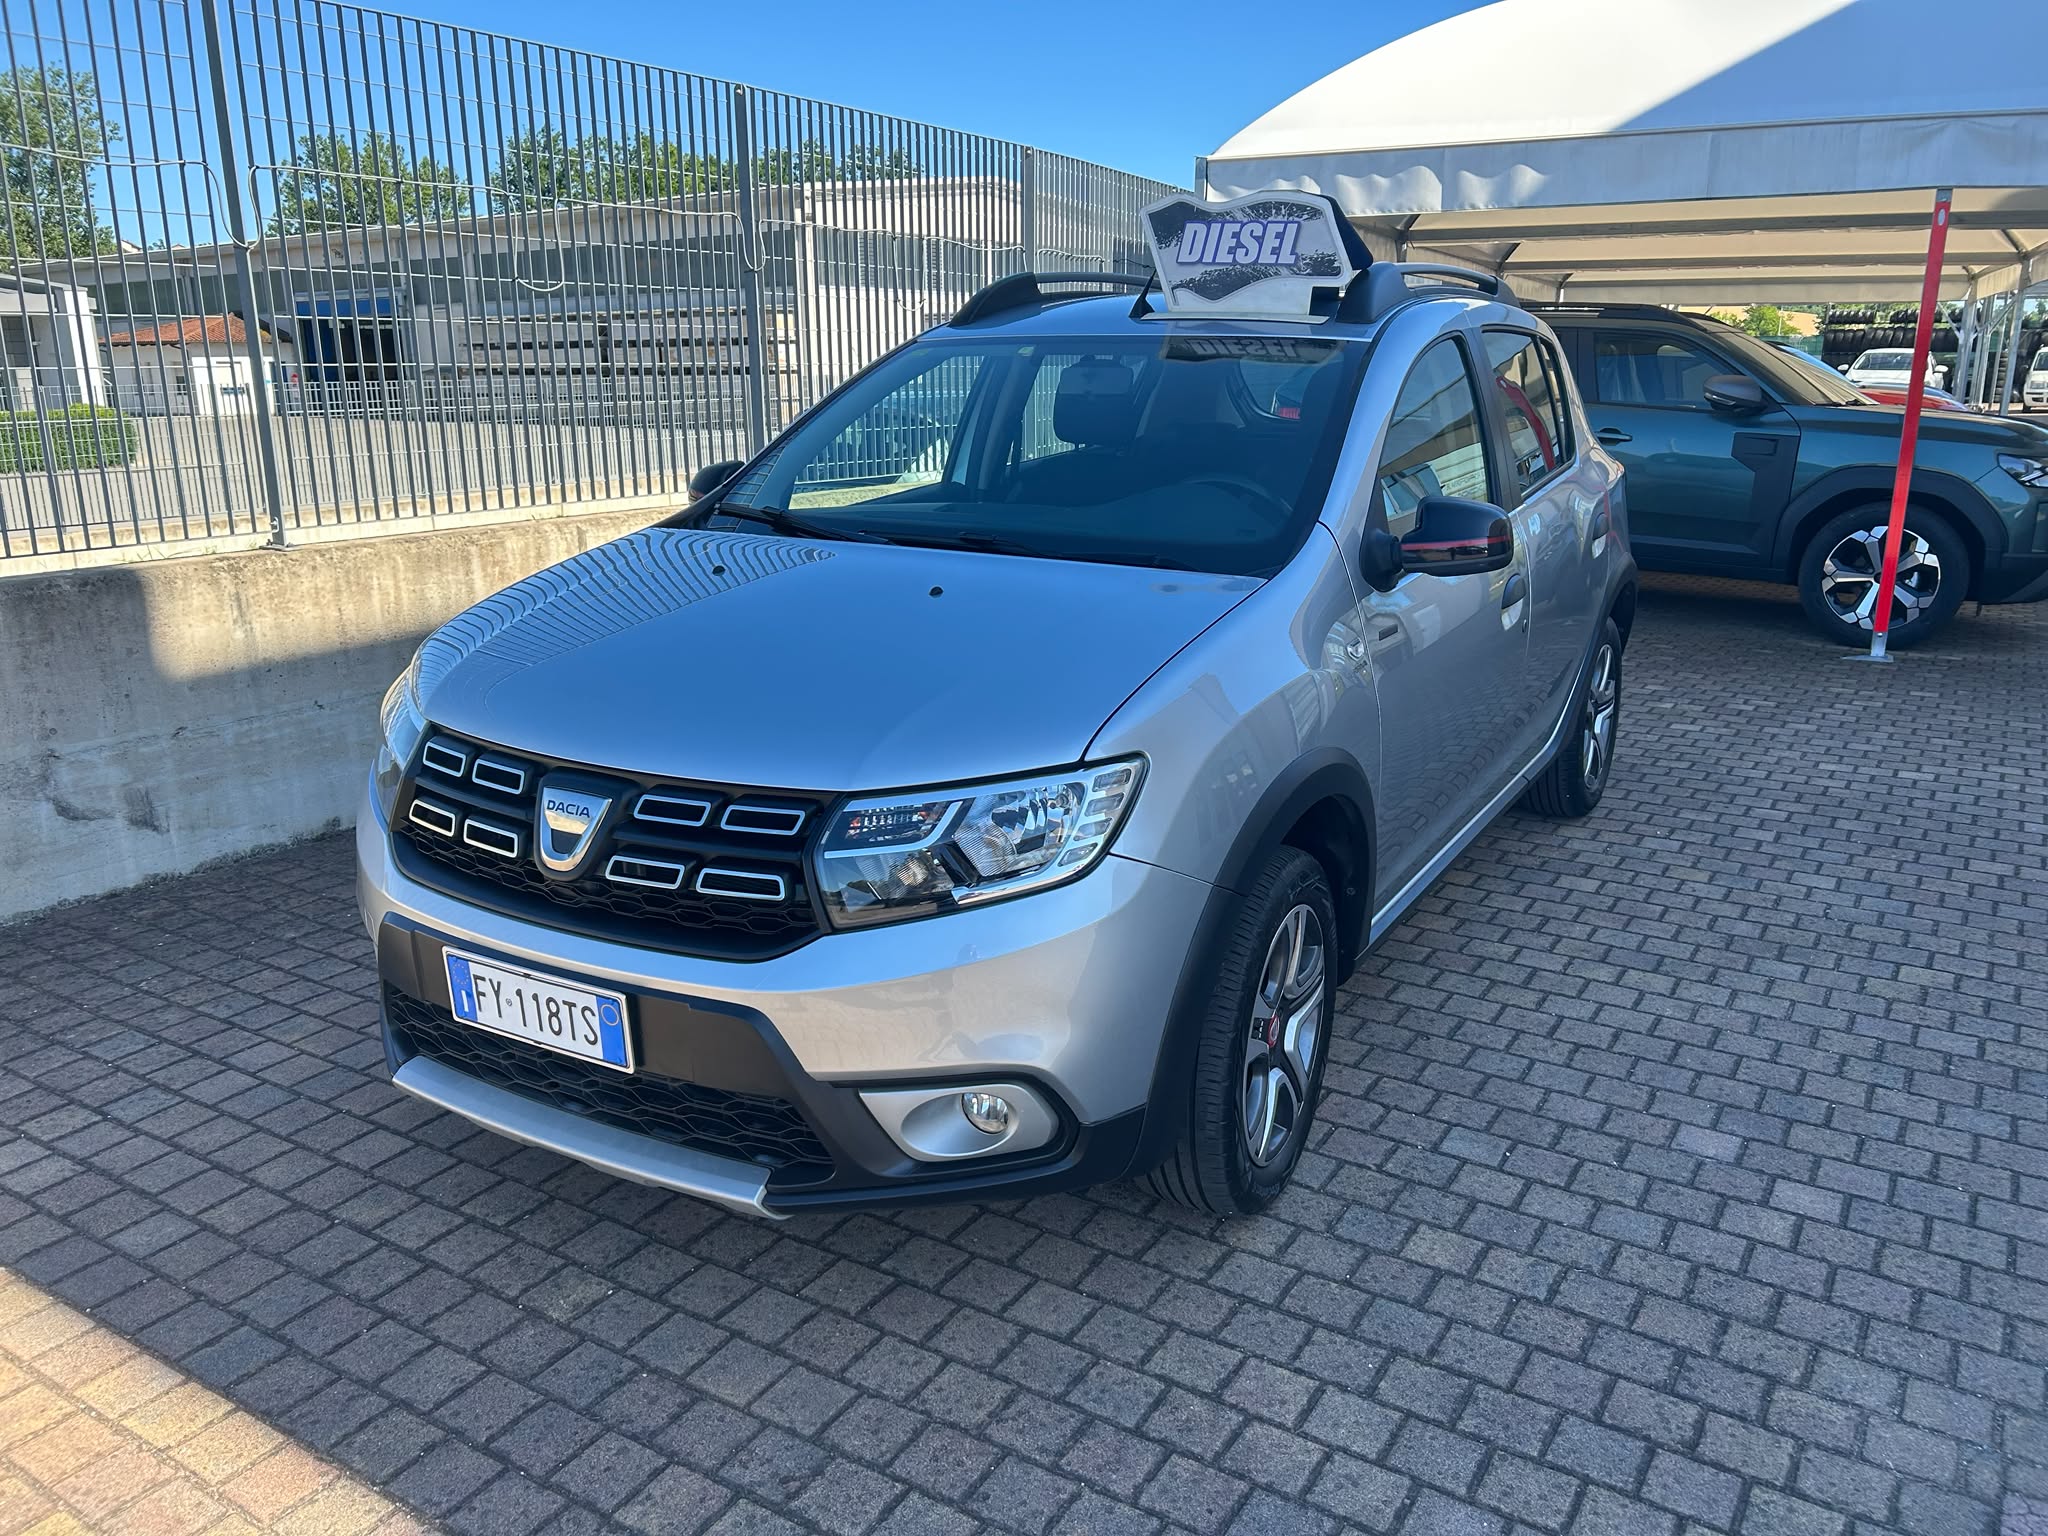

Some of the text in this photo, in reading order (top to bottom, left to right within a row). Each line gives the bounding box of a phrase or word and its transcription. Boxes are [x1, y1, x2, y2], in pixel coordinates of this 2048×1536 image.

[1177, 221, 1300, 265] DIESEL
[546, 799, 591, 819] DACIA
[461, 989, 470, 1013] I
